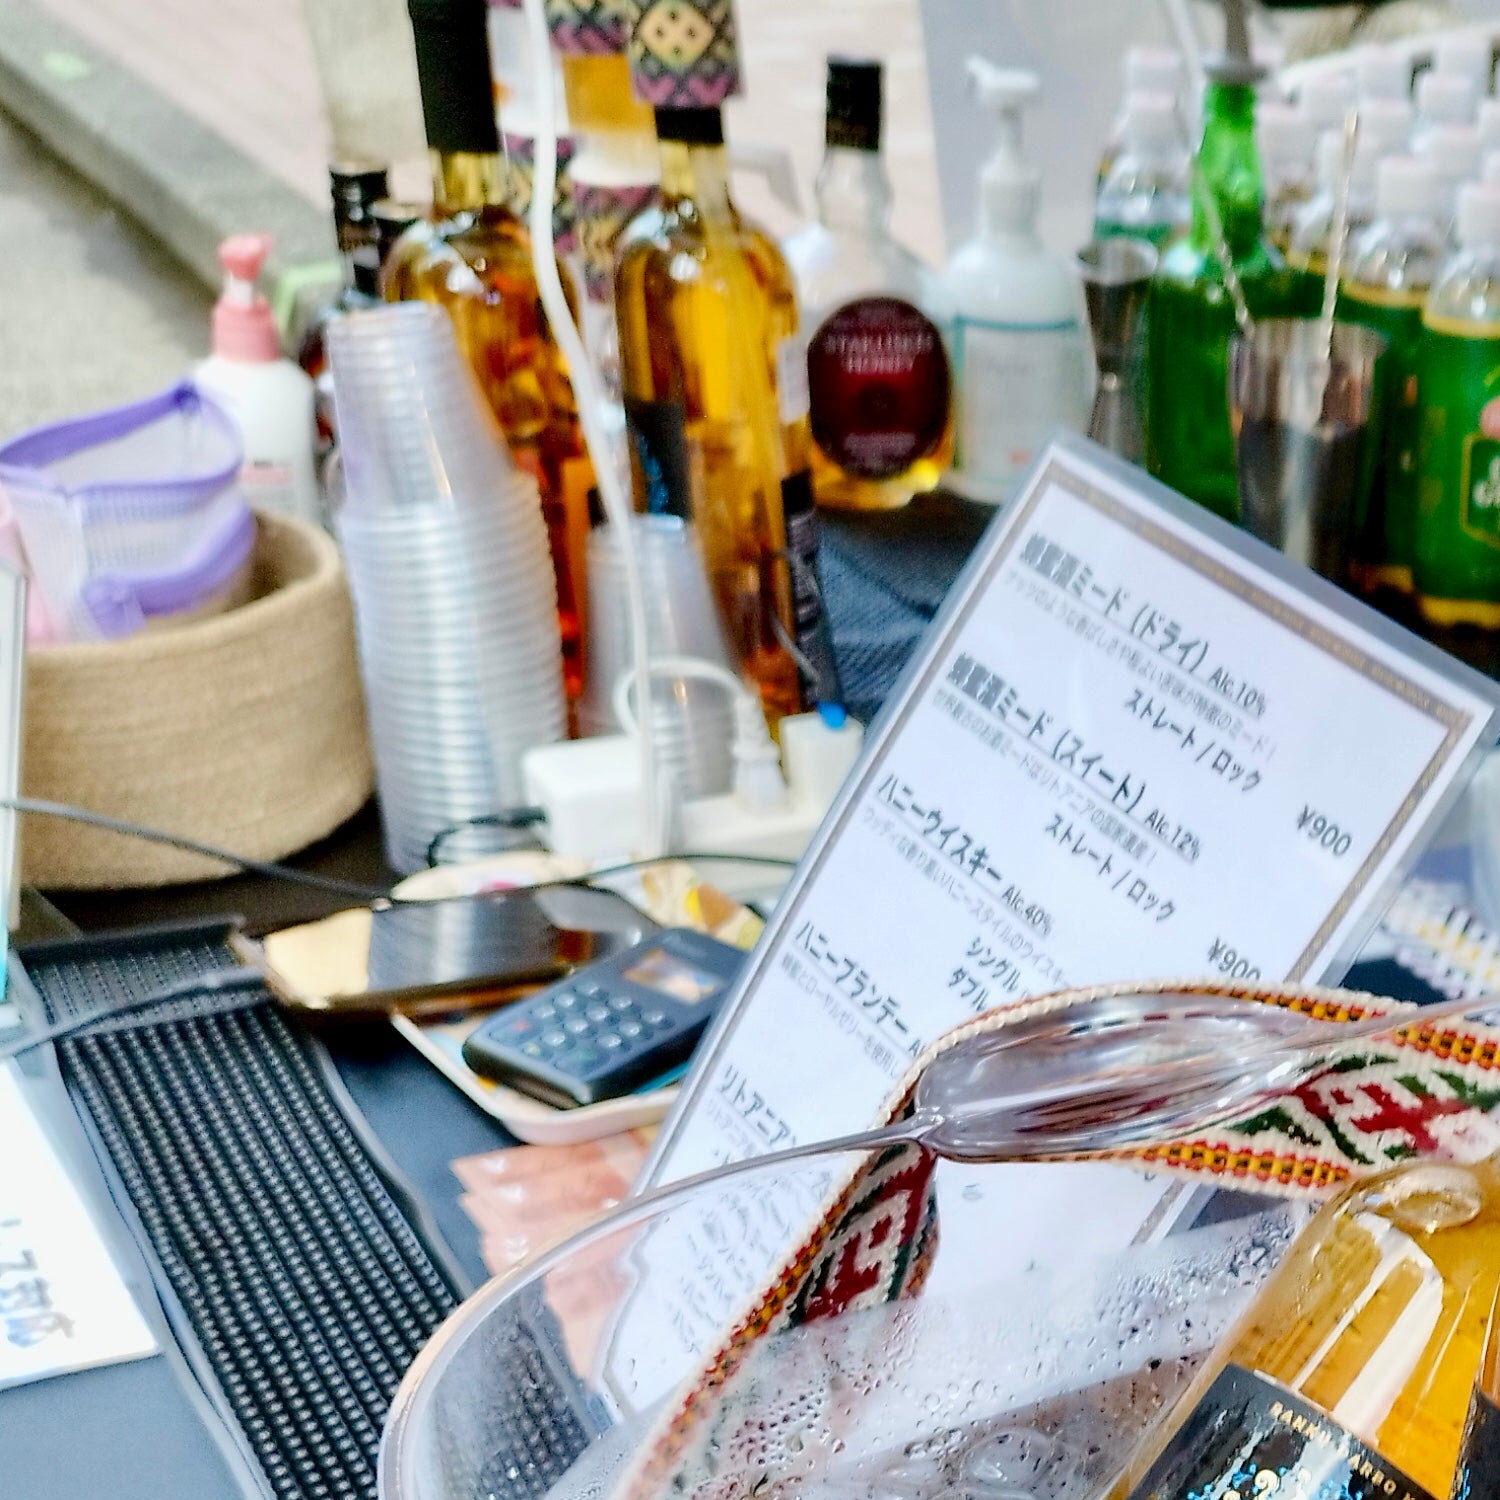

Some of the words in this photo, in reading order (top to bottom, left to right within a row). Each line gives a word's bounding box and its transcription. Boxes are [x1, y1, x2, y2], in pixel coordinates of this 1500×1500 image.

[1123, 687, 1200, 752] ストレート
[1210, 749, 1263, 795] ロック
[877, 773, 1004, 882] ハニーウイスキー
[1043, 812, 1118, 878] ストレート
[1126, 878, 1177, 924] ロック
[1297, 804, 1354, 858] ¥900
